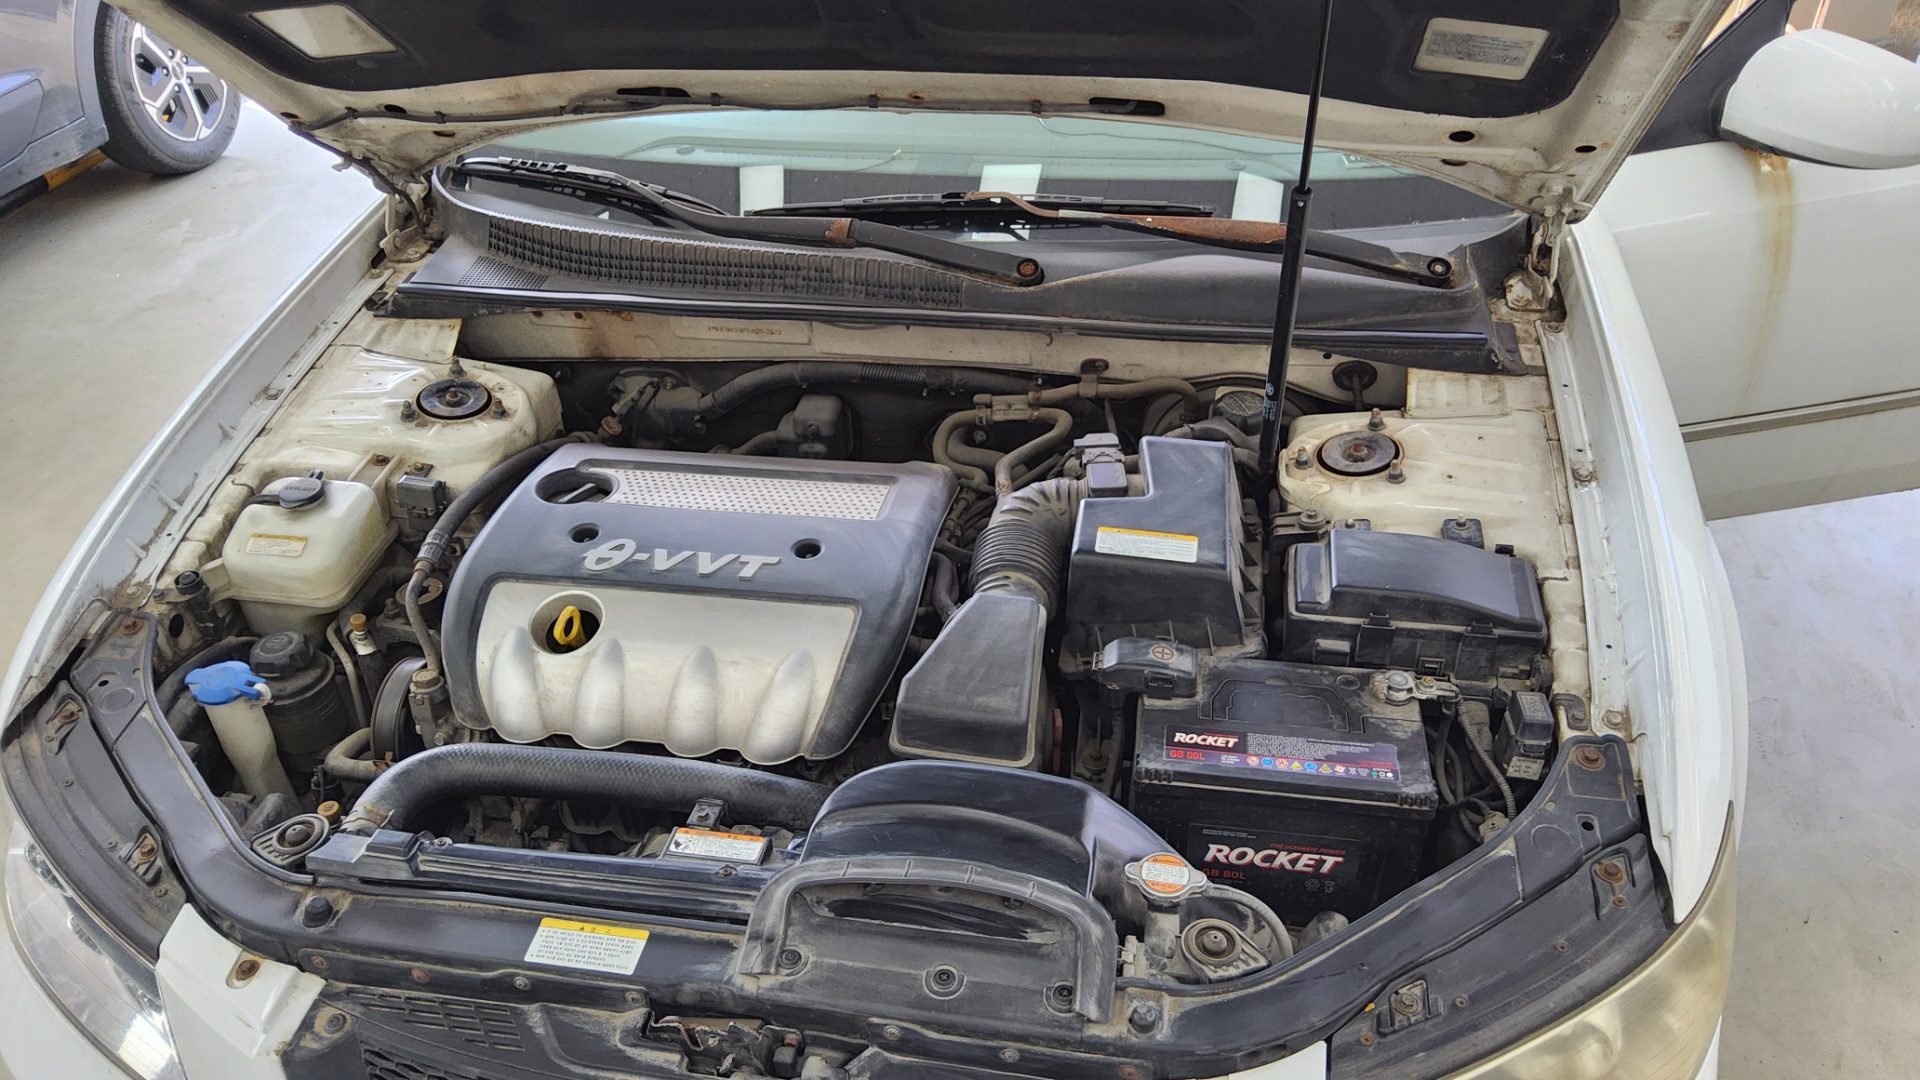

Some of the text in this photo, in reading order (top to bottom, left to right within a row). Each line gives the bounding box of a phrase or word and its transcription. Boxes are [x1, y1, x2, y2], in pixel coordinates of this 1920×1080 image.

[1173, 732, 1239, 748] ROCKET
[1169, 750, 1206, 761] GB 80L
[1203, 843, 1345, 875] ROCKET
[1223, 870, 1247, 880] 80L
